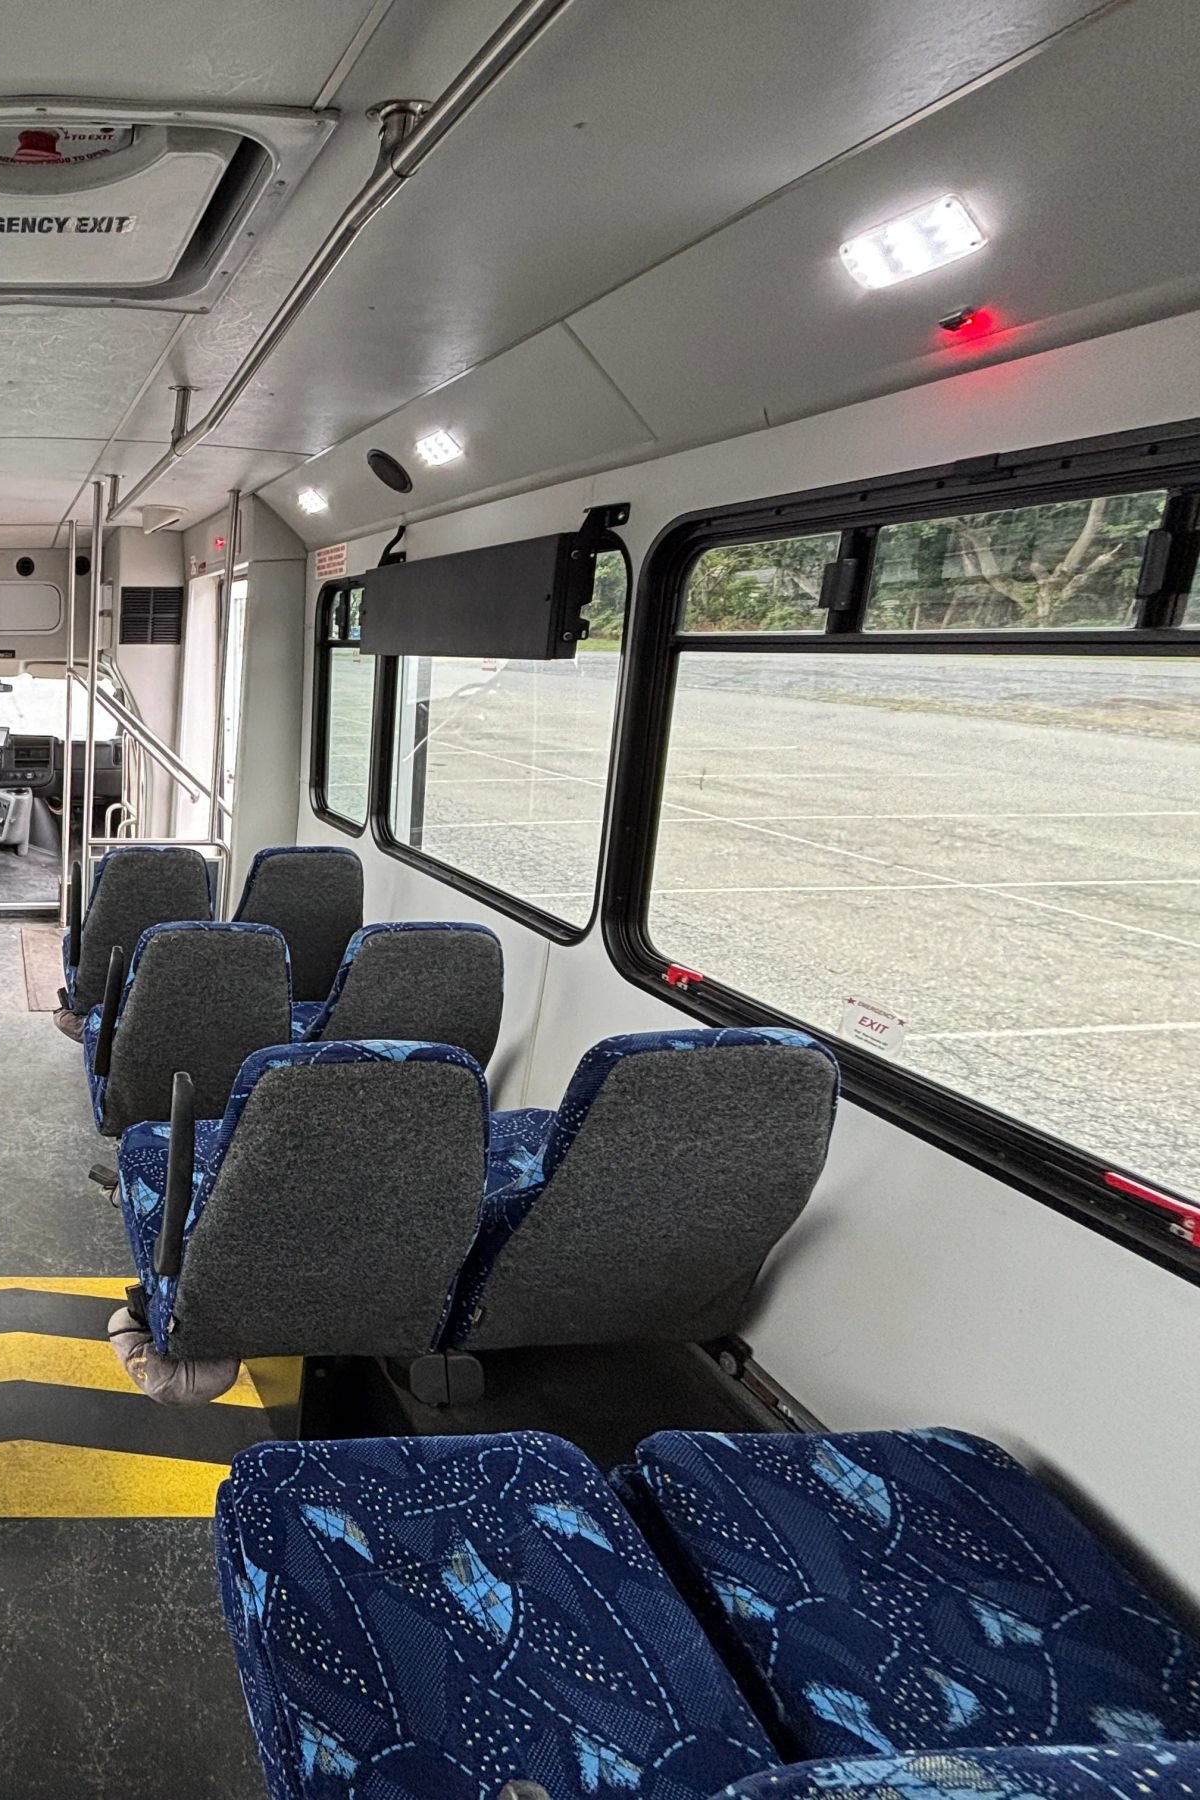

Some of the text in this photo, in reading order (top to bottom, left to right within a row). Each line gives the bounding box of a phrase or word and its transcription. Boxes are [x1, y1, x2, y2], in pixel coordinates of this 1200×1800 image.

[75, 216, 133, 233] EXIT
[857, 1001, 896, 1020] EMERGENCY
[857, 1016, 889, 1035] EXIT
